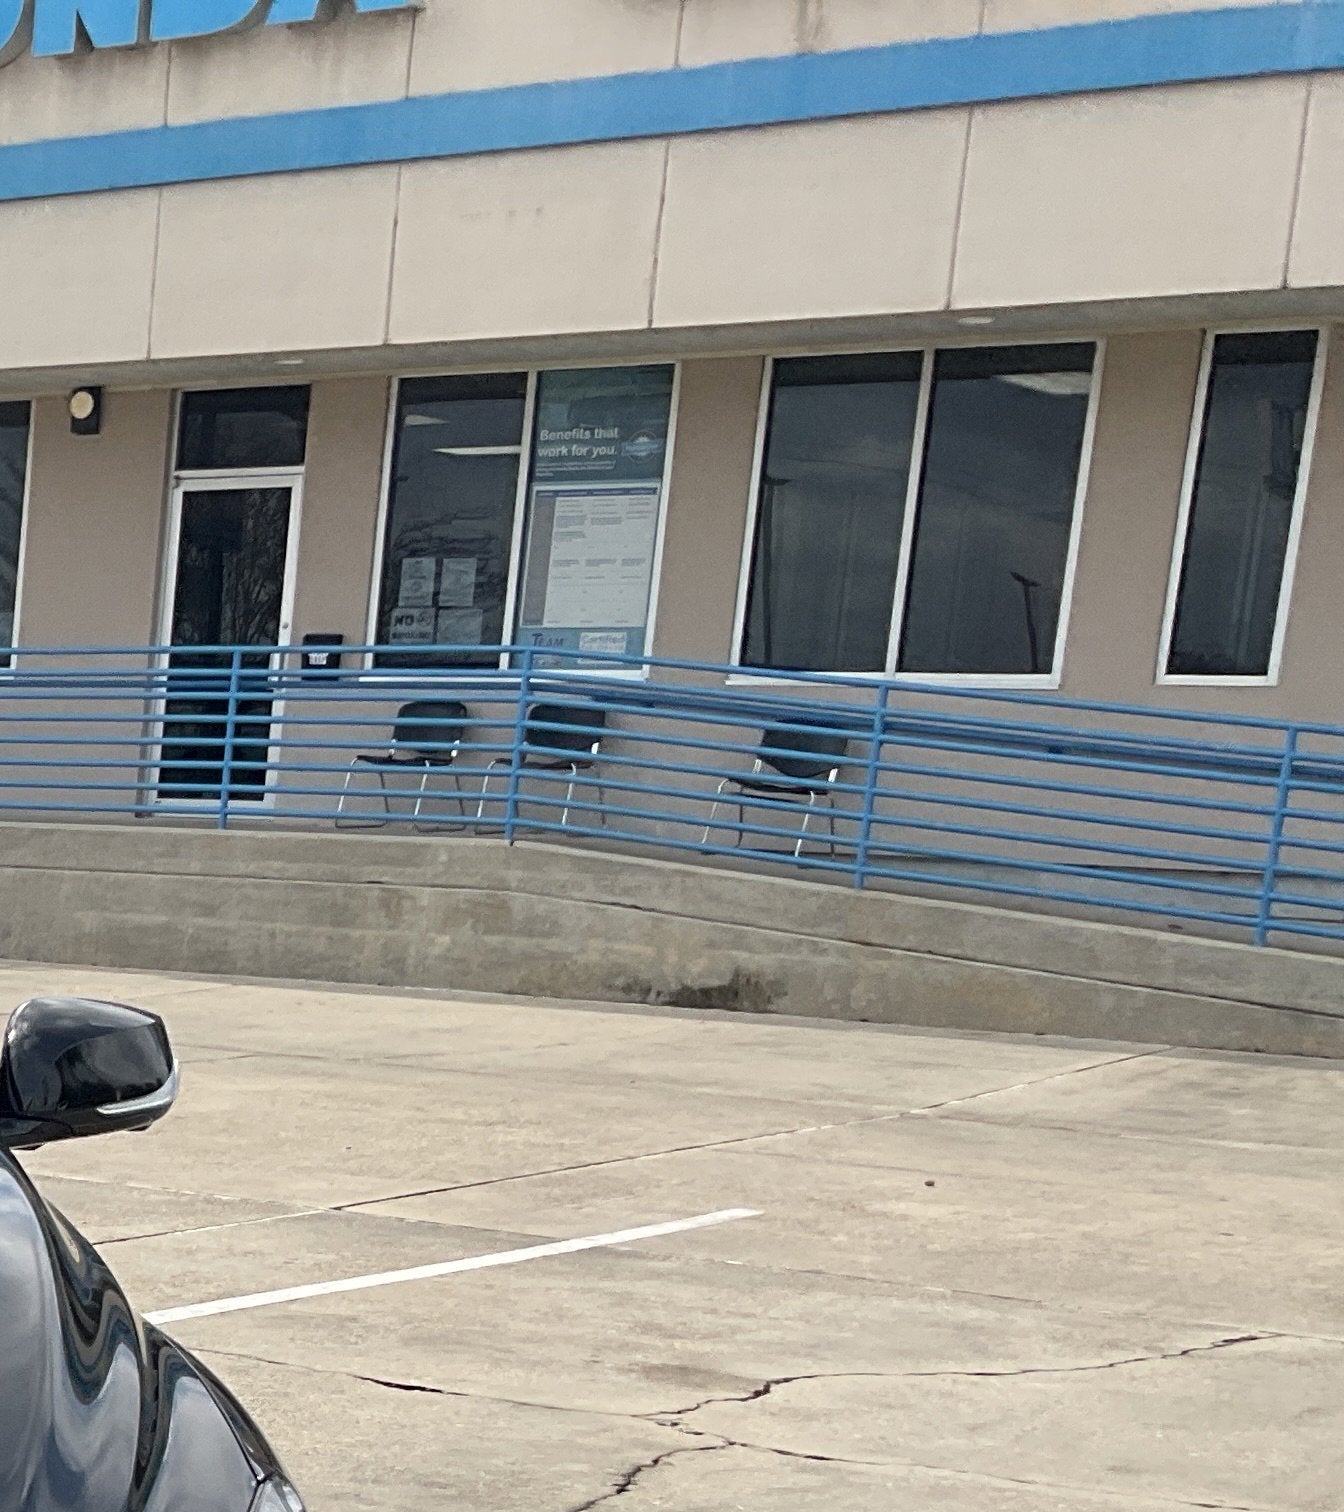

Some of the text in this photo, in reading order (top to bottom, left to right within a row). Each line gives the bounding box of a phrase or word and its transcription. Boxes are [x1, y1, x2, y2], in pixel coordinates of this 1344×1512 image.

[540, 427, 619, 441] Benefits that
[538, 444, 568, 457] work
[571, 444, 590, 456] for
[592, 445, 617, 458] you.
